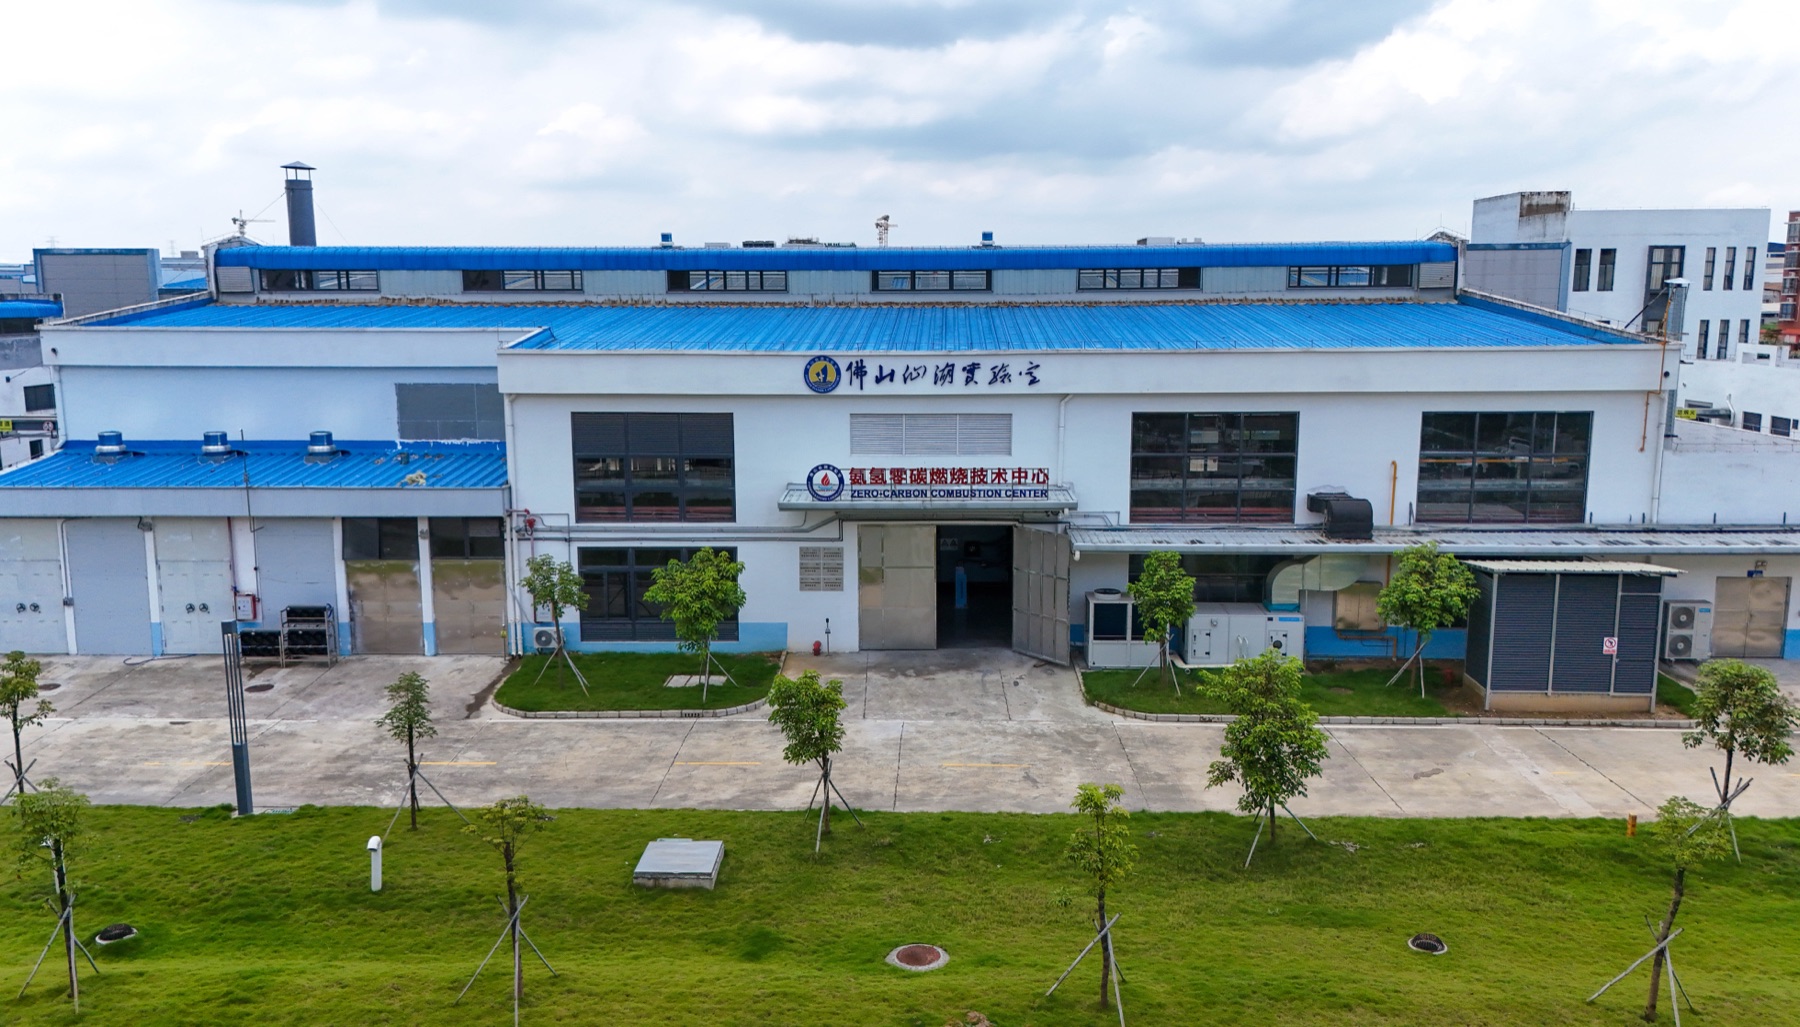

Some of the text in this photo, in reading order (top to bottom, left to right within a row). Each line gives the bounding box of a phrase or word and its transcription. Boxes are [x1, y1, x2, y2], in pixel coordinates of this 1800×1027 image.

[849, 467, 1049, 485] 氨氢零碳燃烧技术中心
[851, 489, 928, 499] ZERO-CARBON
[930, 489, 1002, 499] COMBUSTION
[1004, 489, 1048, 499] CENTER
